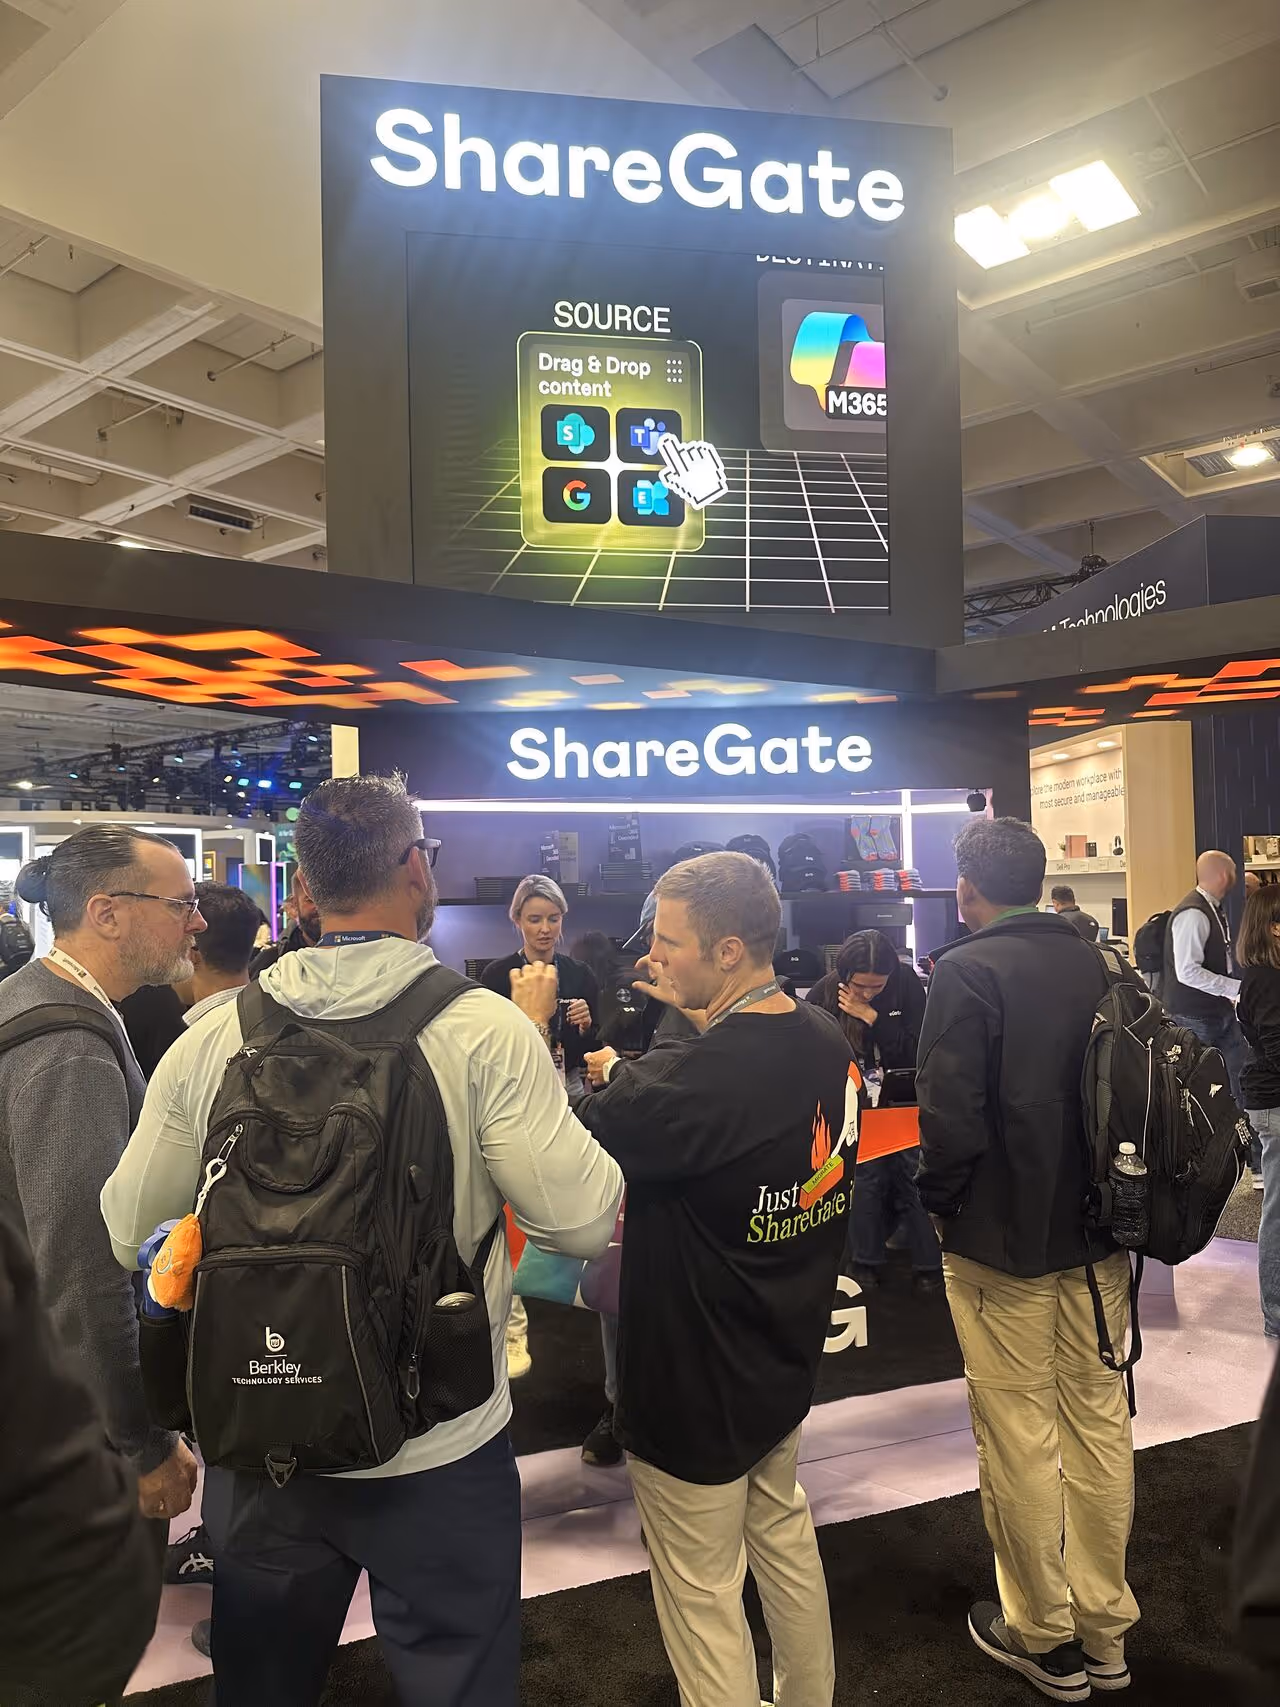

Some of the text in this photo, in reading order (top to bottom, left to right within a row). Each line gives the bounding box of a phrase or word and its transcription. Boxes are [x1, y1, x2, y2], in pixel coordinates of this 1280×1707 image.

[370, 108, 906, 222] ShareGate
[553, 300, 672, 333] SOURCE
[538, 352, 651, 380] Drag & Drop
[538, 379, 612, 397] content
[828, 390, 887, 416] M365
[506, 723, 873, 780] ShareGate
[1053, 779, 1076, 792] modern
[1076, 771, 1107, 787] workplace
[1108, 767, 1122, 780] with
[1039, 798, 1054, 809] most
[1054, 795, 1073, 807] secure
[1073, 791, 1085, 804] and
[811, 1161, 834, 1186] MIGRATE
[752, 1181, 800, 1214] Just
[747, 1191, 846, 1243] ShareGate
[231, 1376, 323, 1385] TECHNOLOGY SERVICES
[249, 1359, 302, 1378] Berkley
